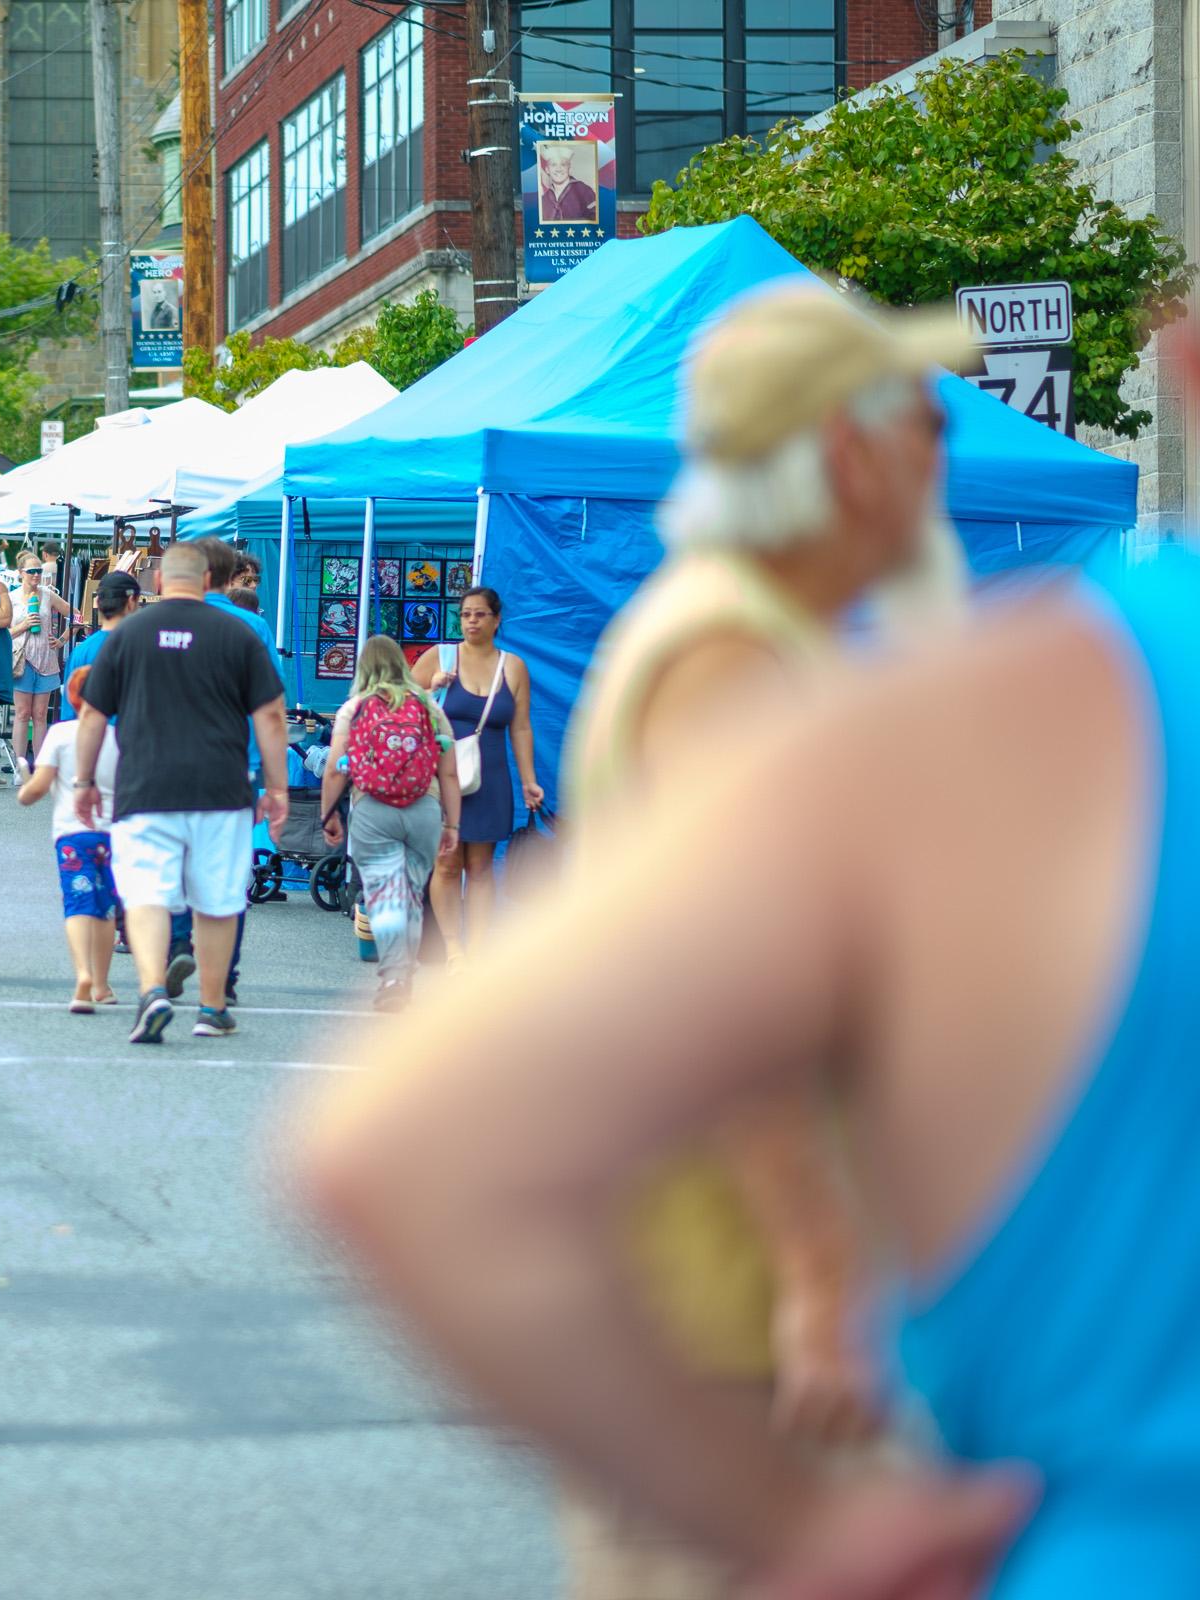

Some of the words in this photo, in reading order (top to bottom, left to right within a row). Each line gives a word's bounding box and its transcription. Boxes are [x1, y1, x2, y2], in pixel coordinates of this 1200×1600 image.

[524, 111, 609, 124] HOMETOWN
[544, 124, 589, 137] HERO
[551, 258, 567, 266] U.S.
[145, 270, 173, 278] HERO
[967, 297, 1062, 335] NORTH
[978, 376, 1062, 431] 74
